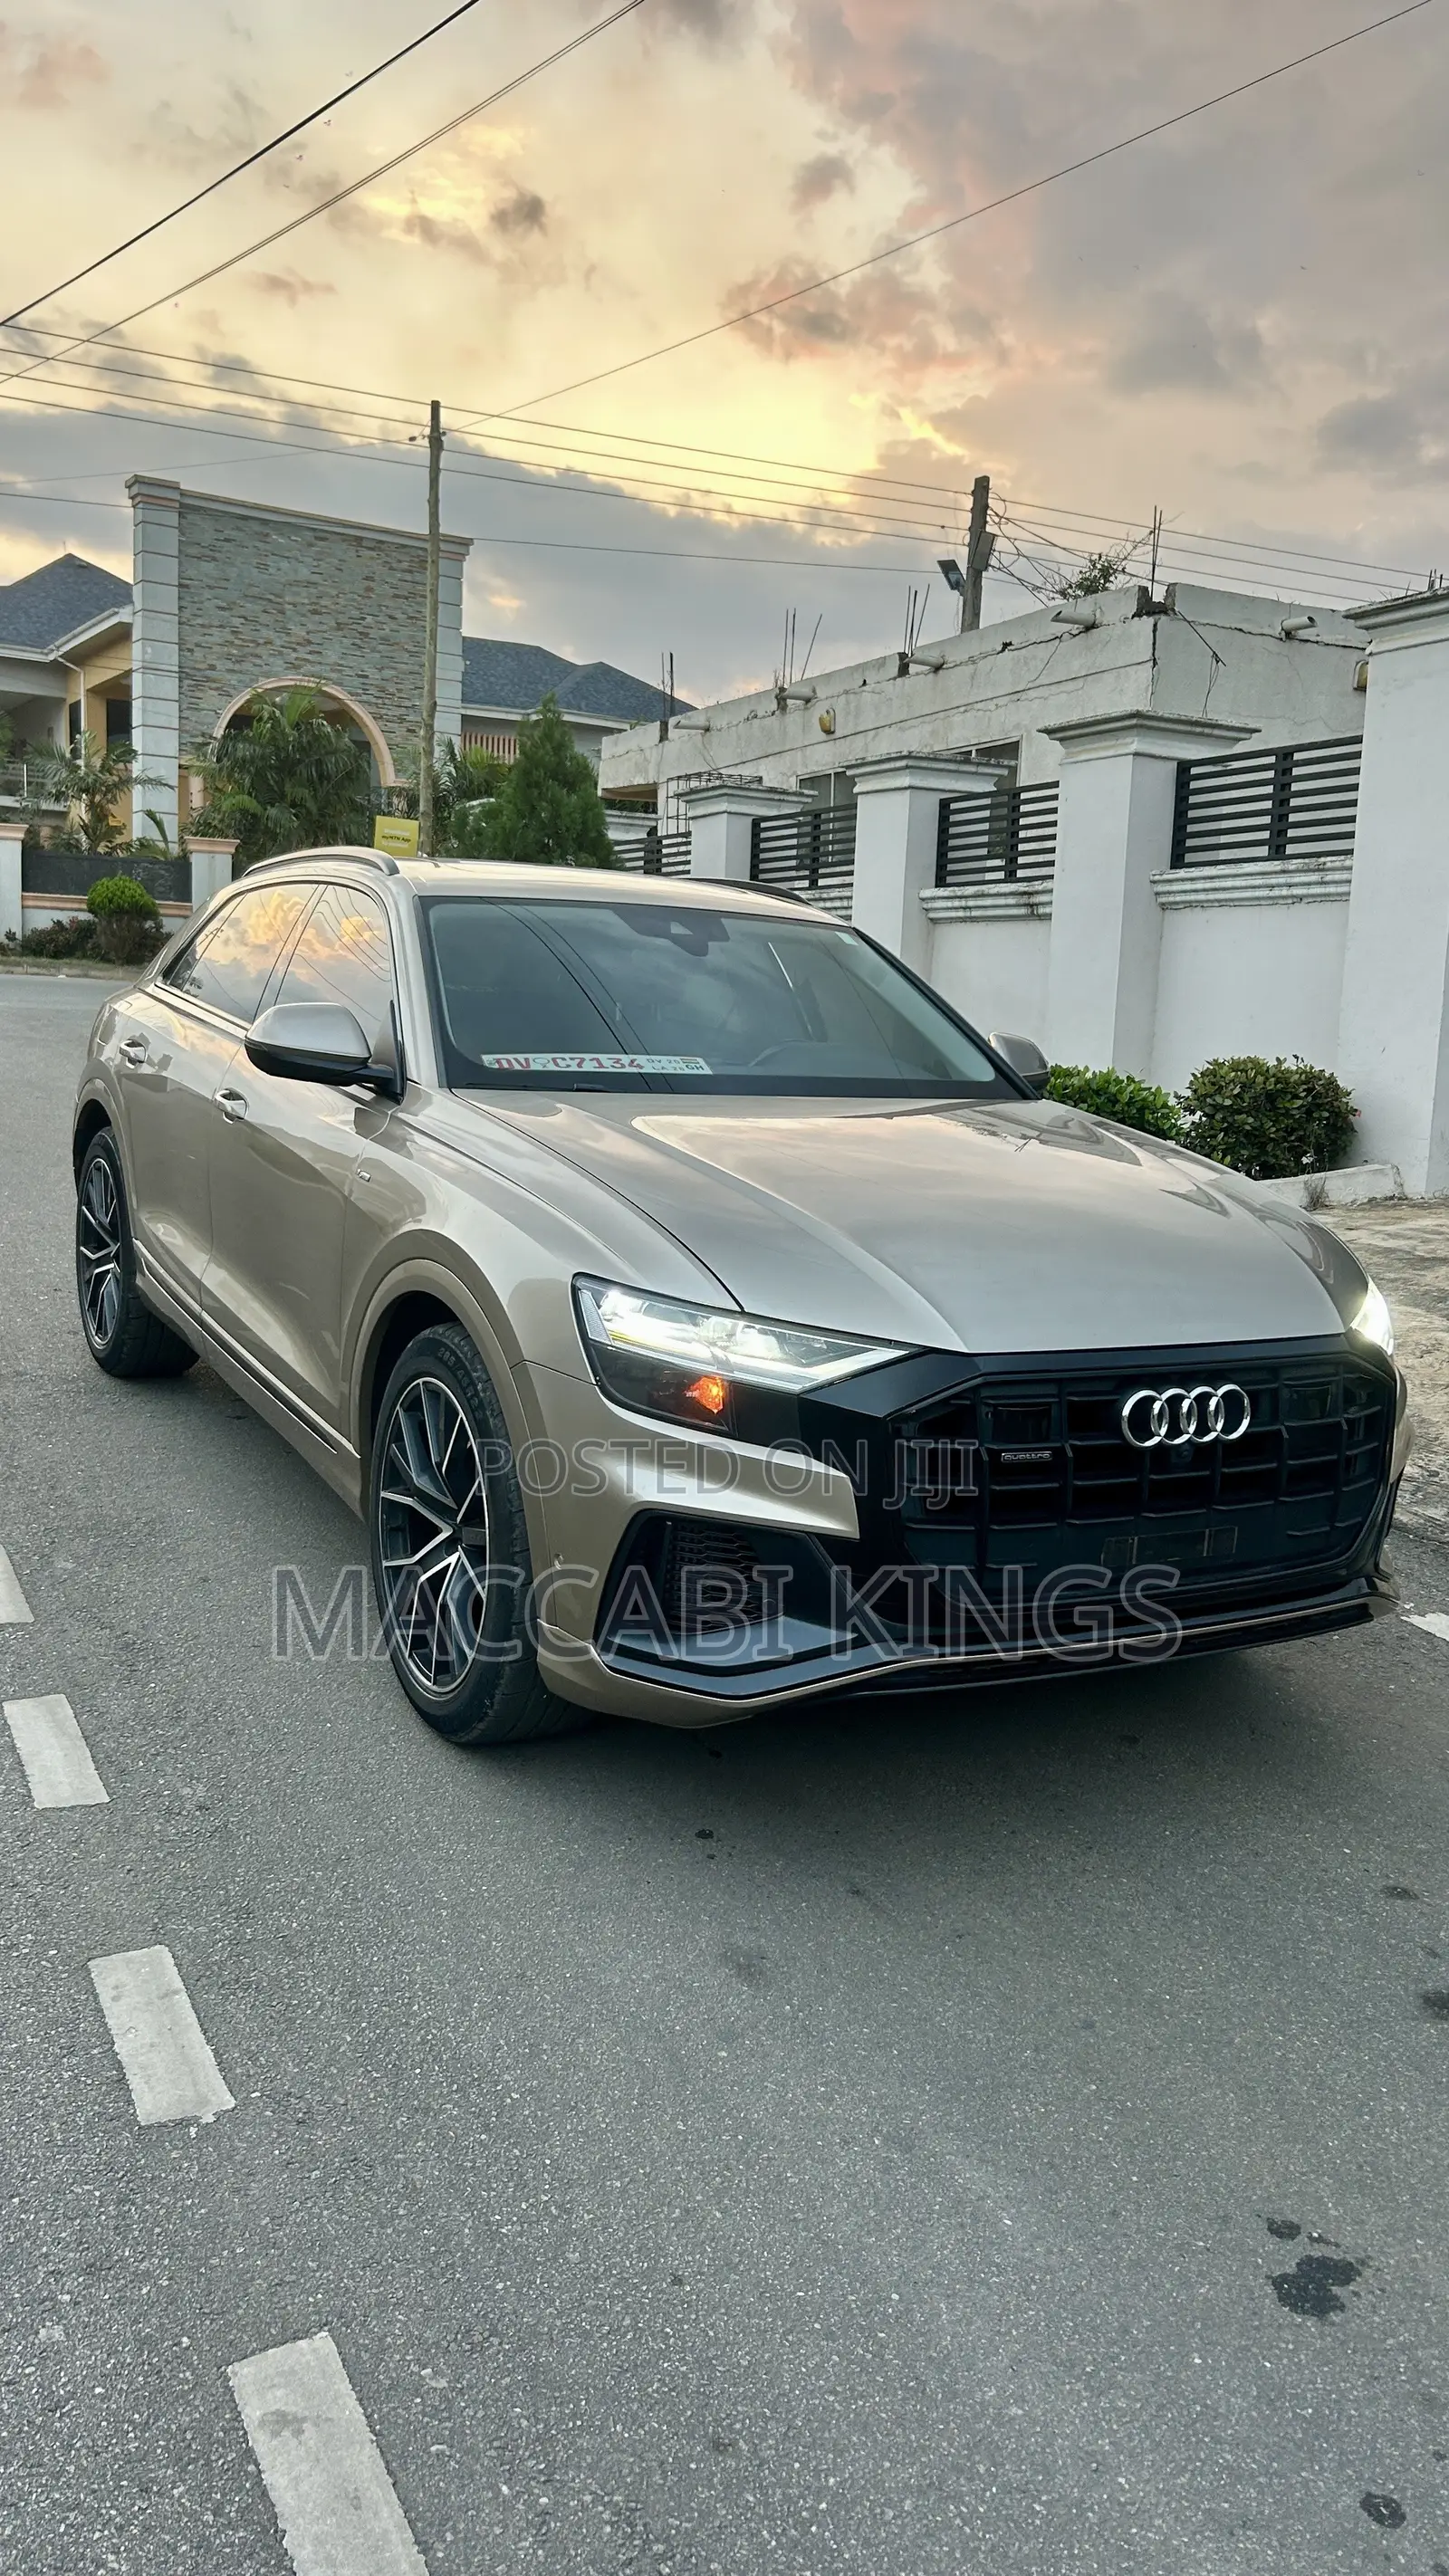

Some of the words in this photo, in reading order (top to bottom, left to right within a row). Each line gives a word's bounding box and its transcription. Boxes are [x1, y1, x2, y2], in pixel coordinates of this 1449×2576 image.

[494, 1057, 531, 1069] DV
[552, 1057, 645, 1070] C7134
[1003, 1452, 1051, 1460] quattro
